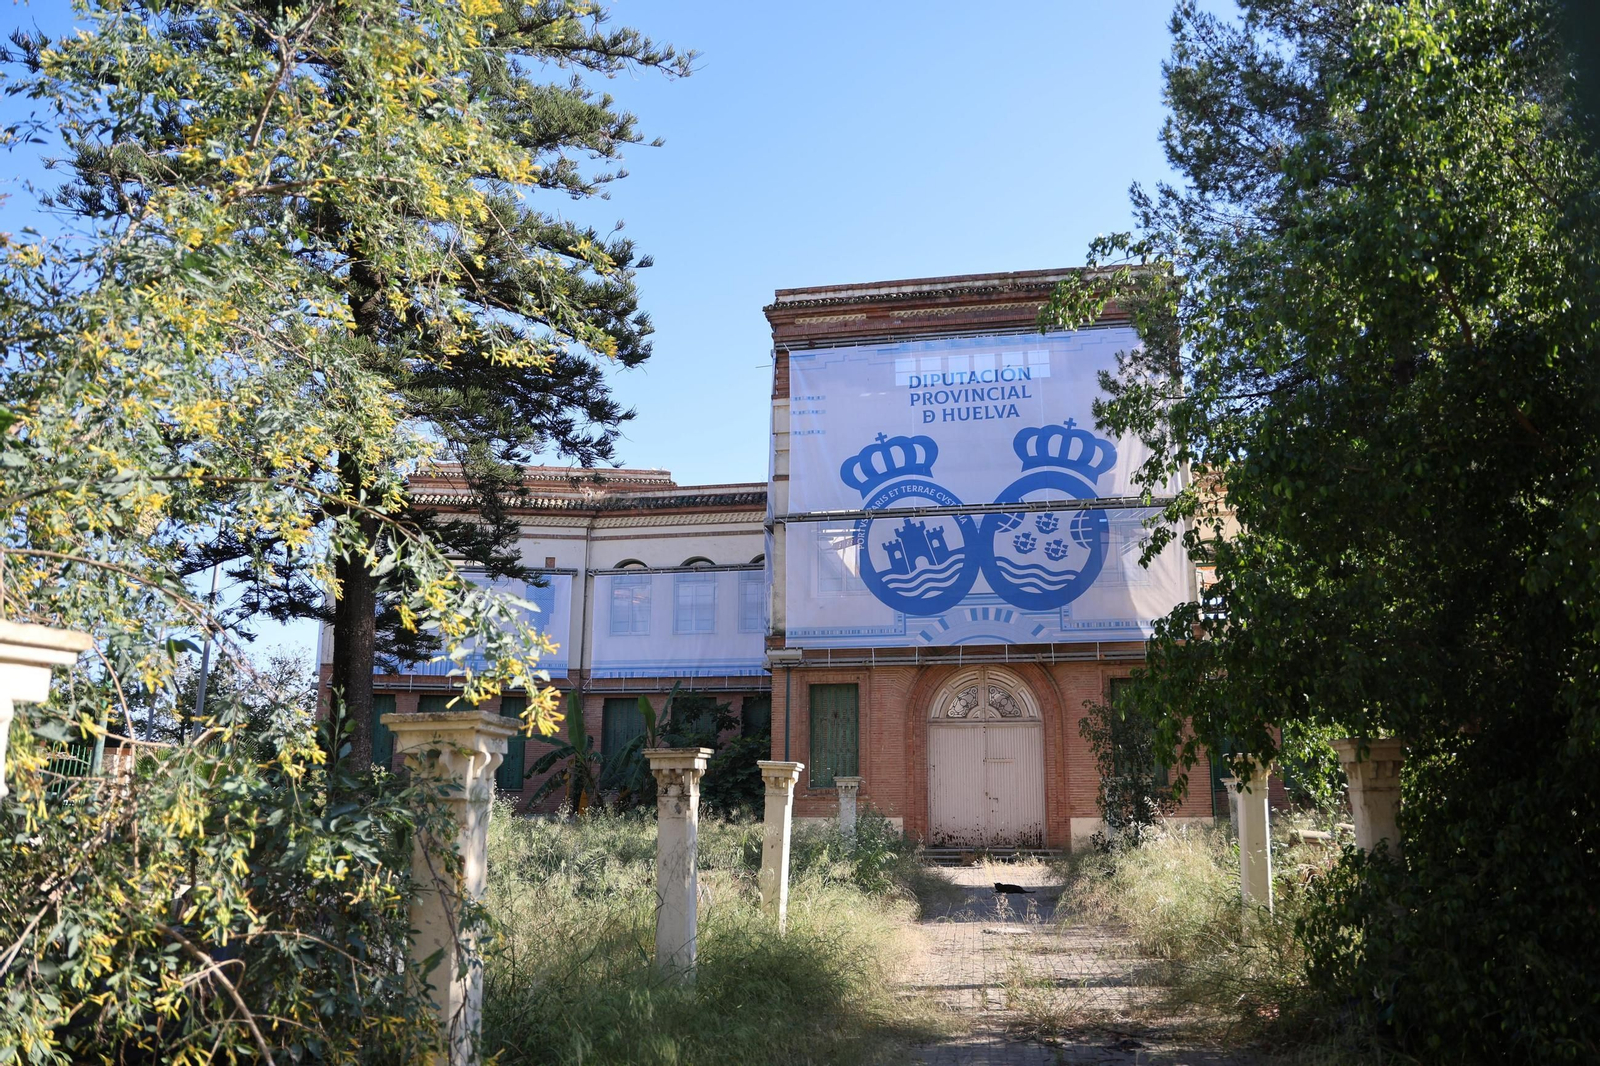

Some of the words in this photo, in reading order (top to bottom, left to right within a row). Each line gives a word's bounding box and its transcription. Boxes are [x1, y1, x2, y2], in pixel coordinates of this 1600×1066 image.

[908, 364, 1032, 389] DIPUTACIÓN
[910, 385, 1032, 407] PROVINCIAL
[942, 403, 1020, 422] HUELVA
[866, 494, 889, 511] ARIS
[888, 487, 900, 498] ET
[900, 484, 936, 497] TERRAE
